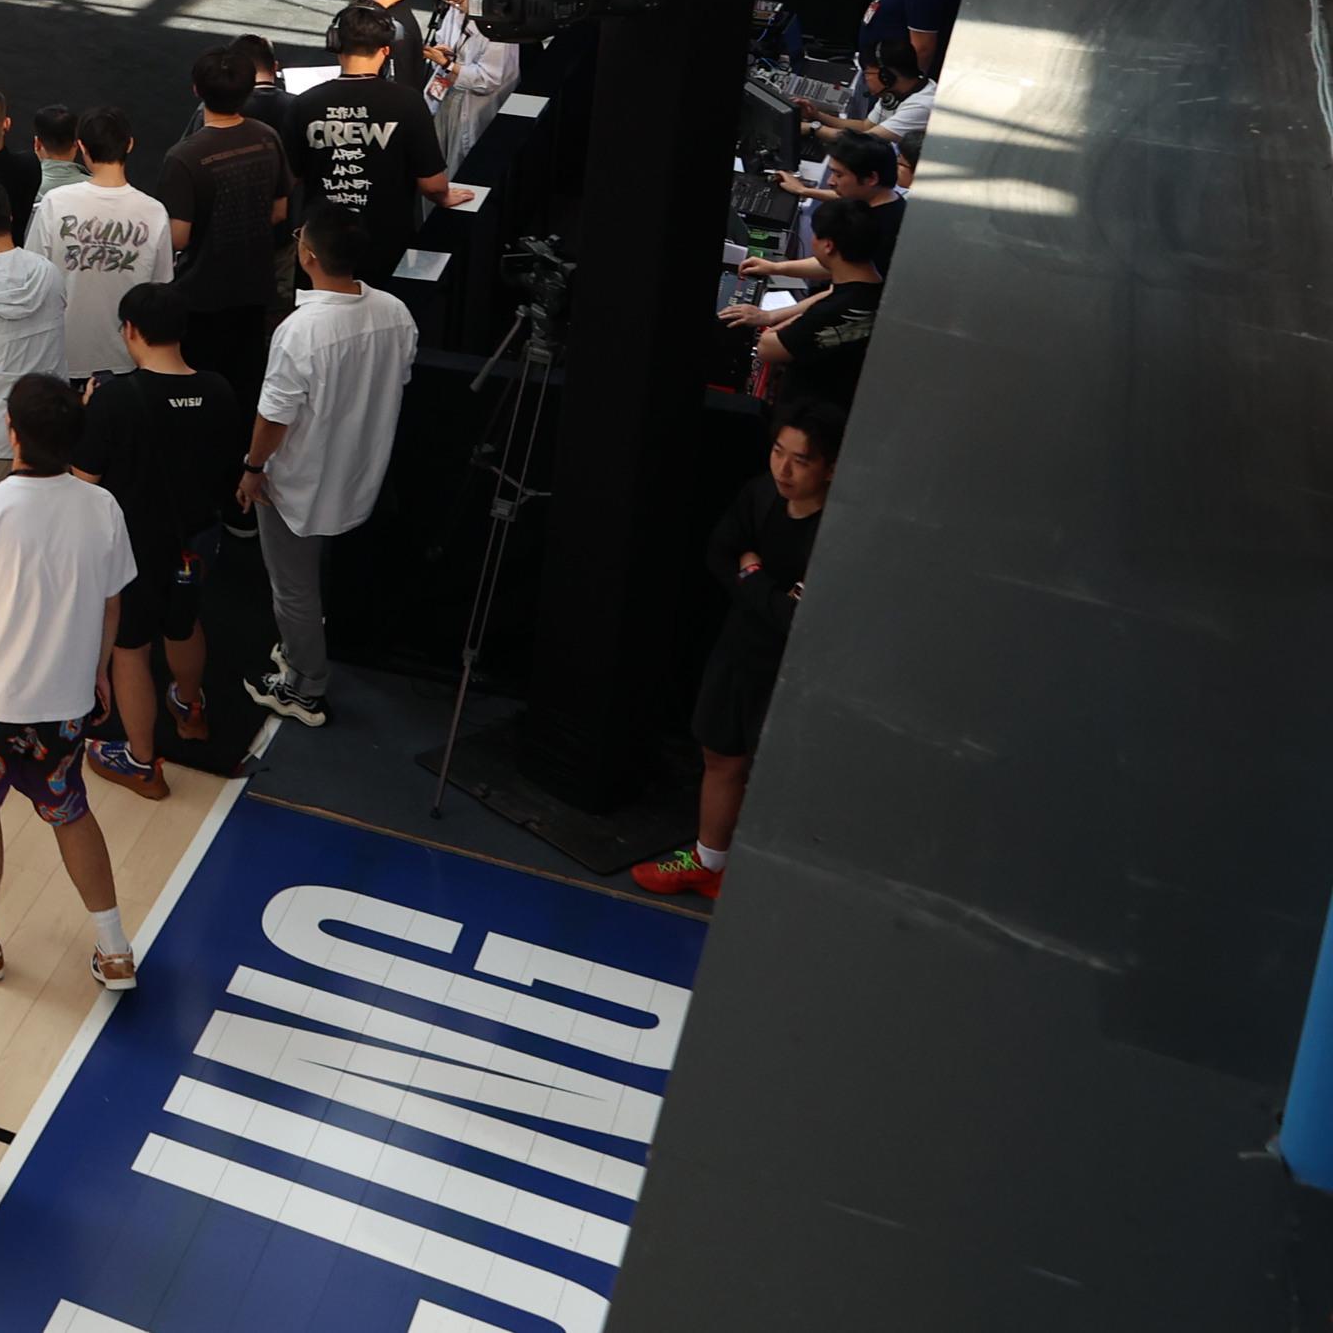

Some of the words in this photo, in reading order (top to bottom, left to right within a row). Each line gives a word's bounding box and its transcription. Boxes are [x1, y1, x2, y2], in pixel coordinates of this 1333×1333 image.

[306, 120, 399, 150] CREW
[332, 164, 364, 176] AND
[168, 397, 203, 408] EVISU
